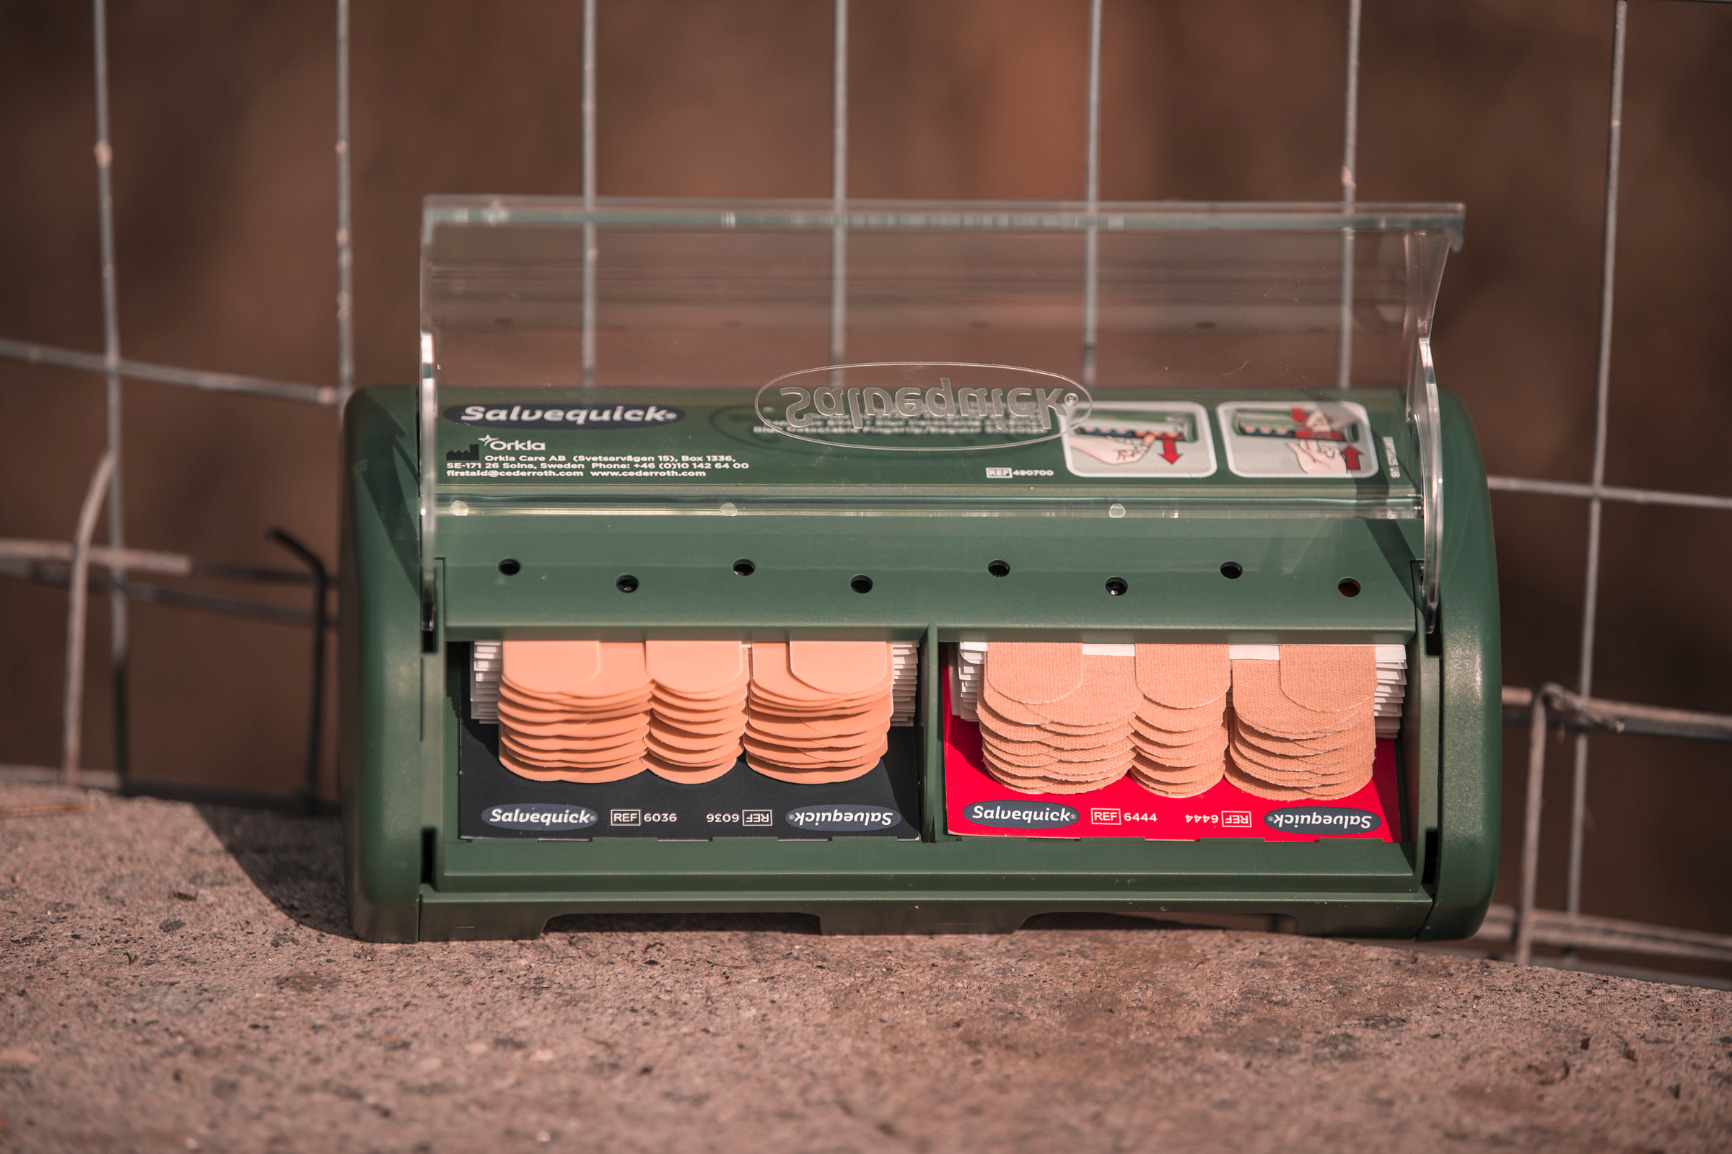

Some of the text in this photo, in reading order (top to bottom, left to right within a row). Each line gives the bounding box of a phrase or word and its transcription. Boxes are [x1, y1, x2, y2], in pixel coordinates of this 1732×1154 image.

[489, 439, 546, 451] Orkla
[502, 462, 537, 470] Solna,
[659, 462, 689, 470] (0)10
[614, 813, 638, 822] REF
[644, 813, 677, 822] 6036
[706, 813, 740, 822] 6036
[746, 813, 770, 823] REF
[1094, 811, 1118, 821] REF
[1124, 813, 1158, 822] 6444
[1185, 814, 1219, 823] 6444
[1225, 814, 1249, 824] REF
